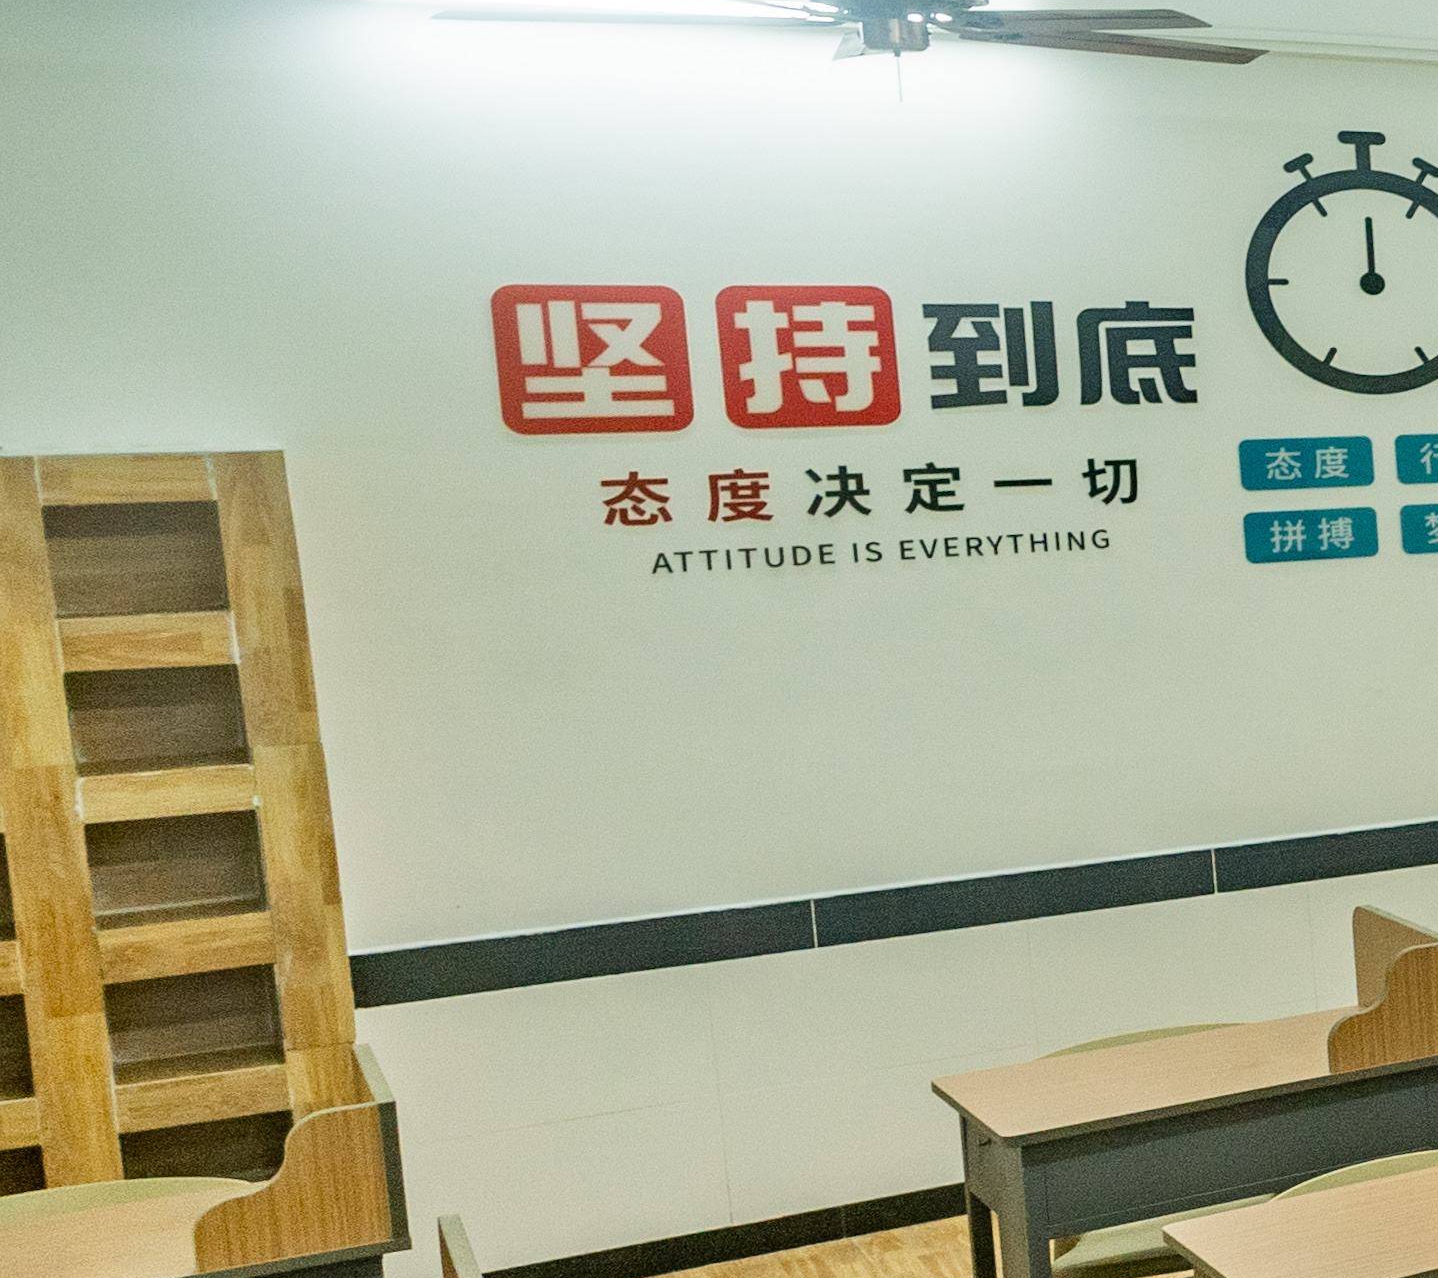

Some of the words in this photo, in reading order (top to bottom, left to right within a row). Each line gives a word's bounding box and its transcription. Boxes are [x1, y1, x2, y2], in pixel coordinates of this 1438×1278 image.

[513, 298, 1200, 421] 坚持到底
[1264, 445, 1350, 481] 态度
[600, 458, 1139, 527] 态度决定一切
[651, 542, 836, 575] ATTITUDE
[851, 540, 884, 564] IS
[898, 528, 1112, 562] EVERYTHING
[1270, 517, 1355, 554] 拼搏
